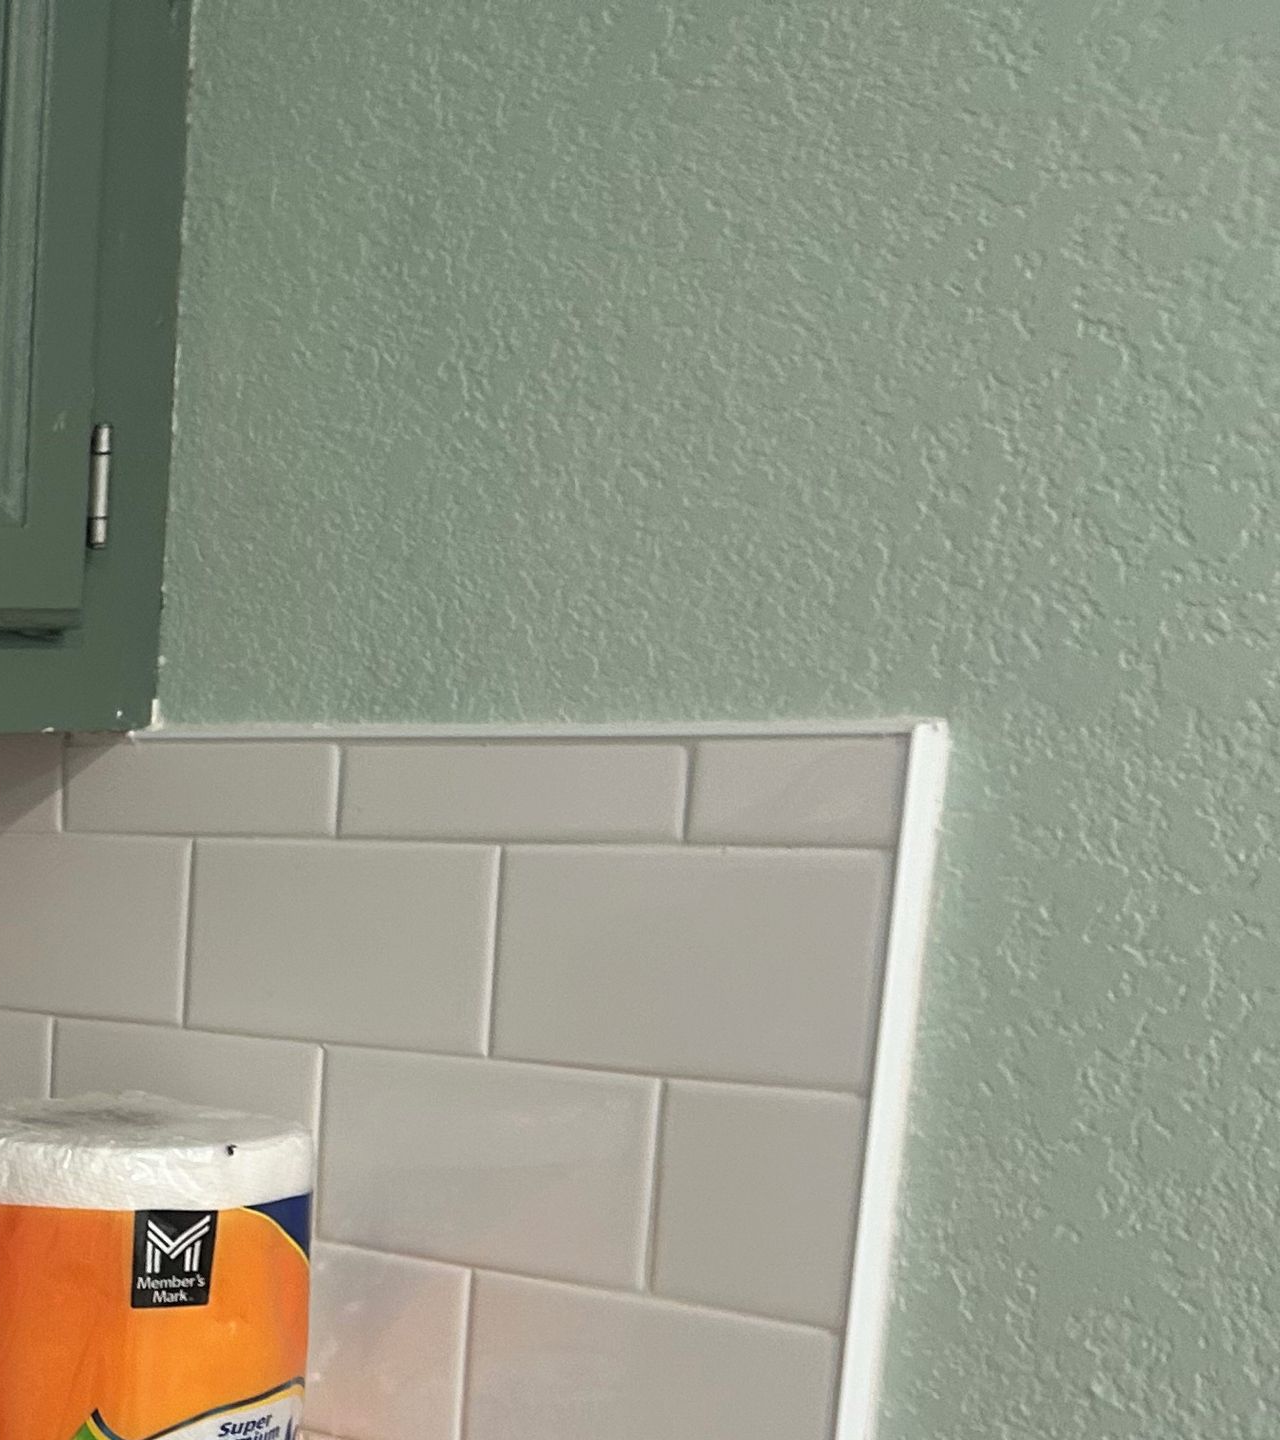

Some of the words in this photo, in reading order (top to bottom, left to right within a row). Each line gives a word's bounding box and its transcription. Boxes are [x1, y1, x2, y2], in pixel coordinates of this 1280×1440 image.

[136, 1274, 206, 1290] Member's
[152, 1289, 188, 1303] Mark
[217, 1414, 273, 1439] Super
